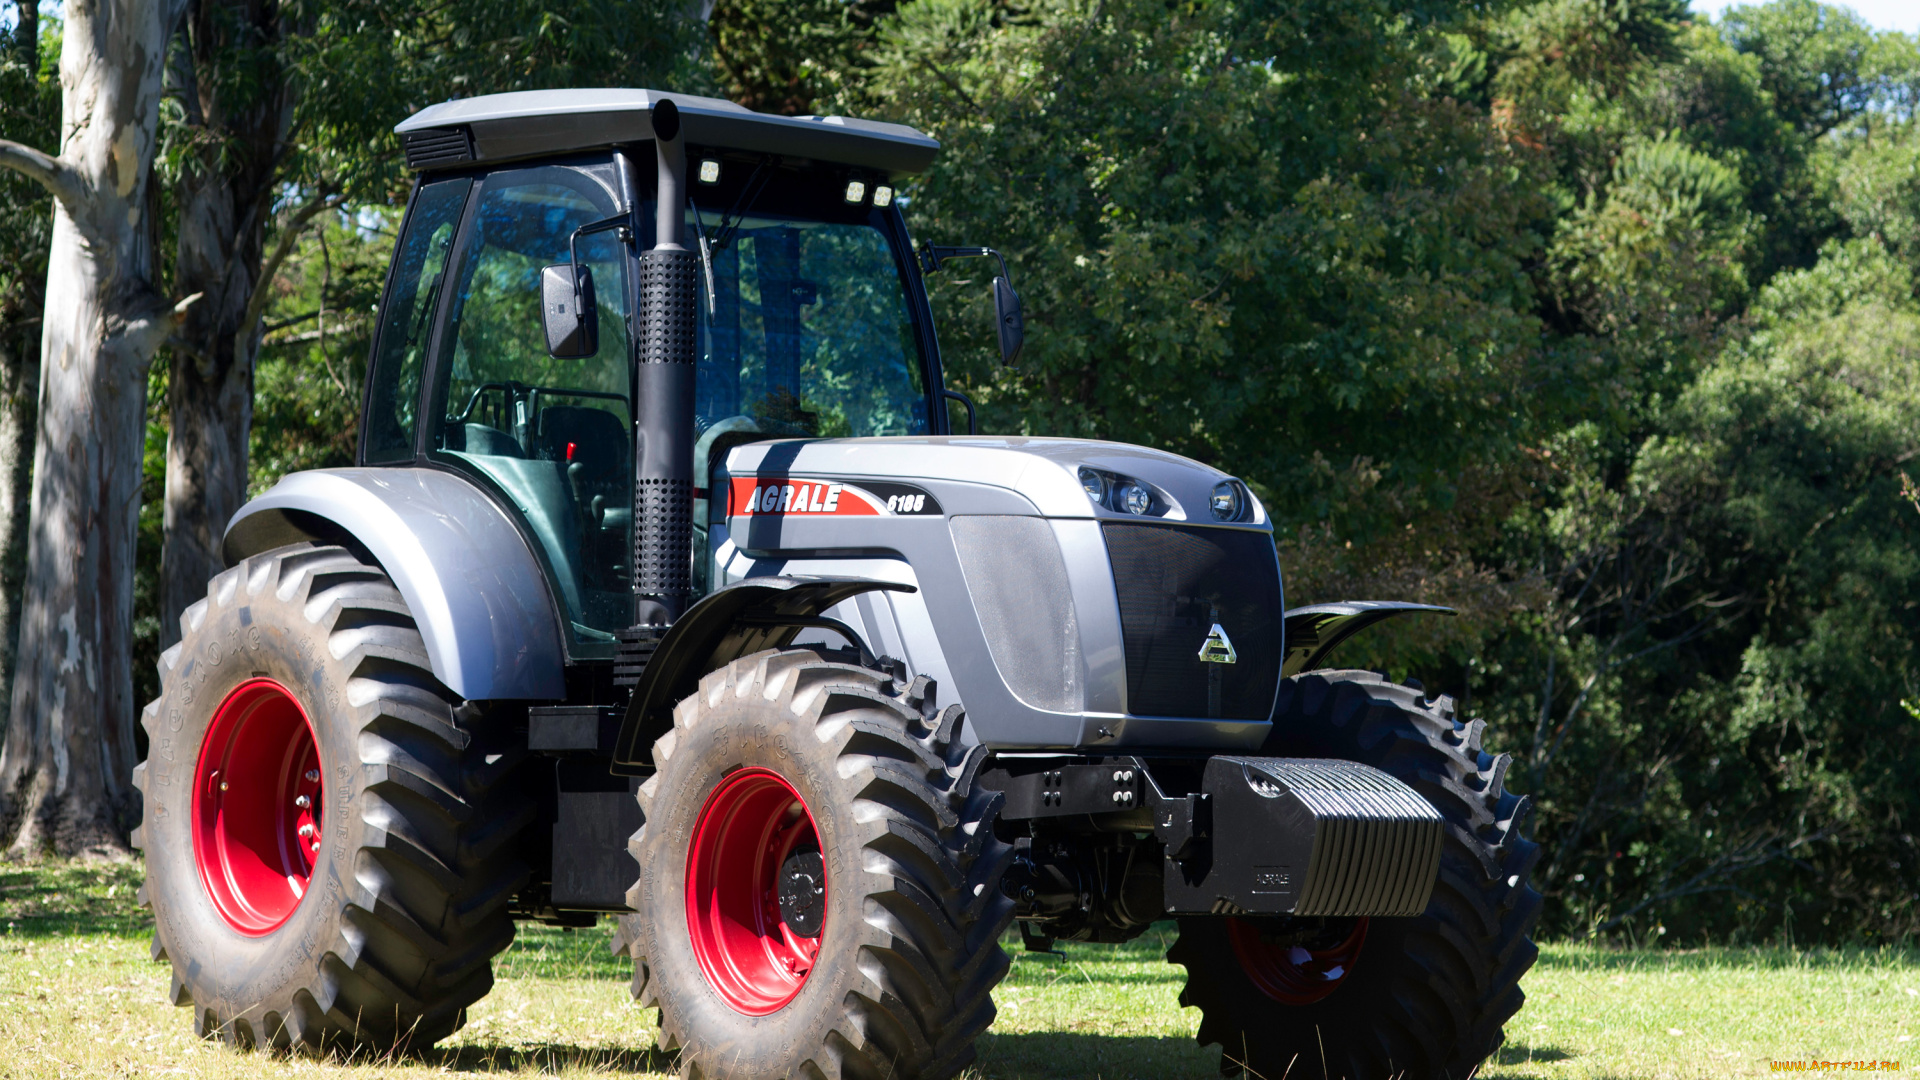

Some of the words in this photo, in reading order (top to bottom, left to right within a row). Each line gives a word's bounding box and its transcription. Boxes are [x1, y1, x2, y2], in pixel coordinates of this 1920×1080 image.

[744, 484, 843, 513] AGRALE
[333, 765, 350, 860] SUPER
[1256, 873, 1290, 885] AGRALE
